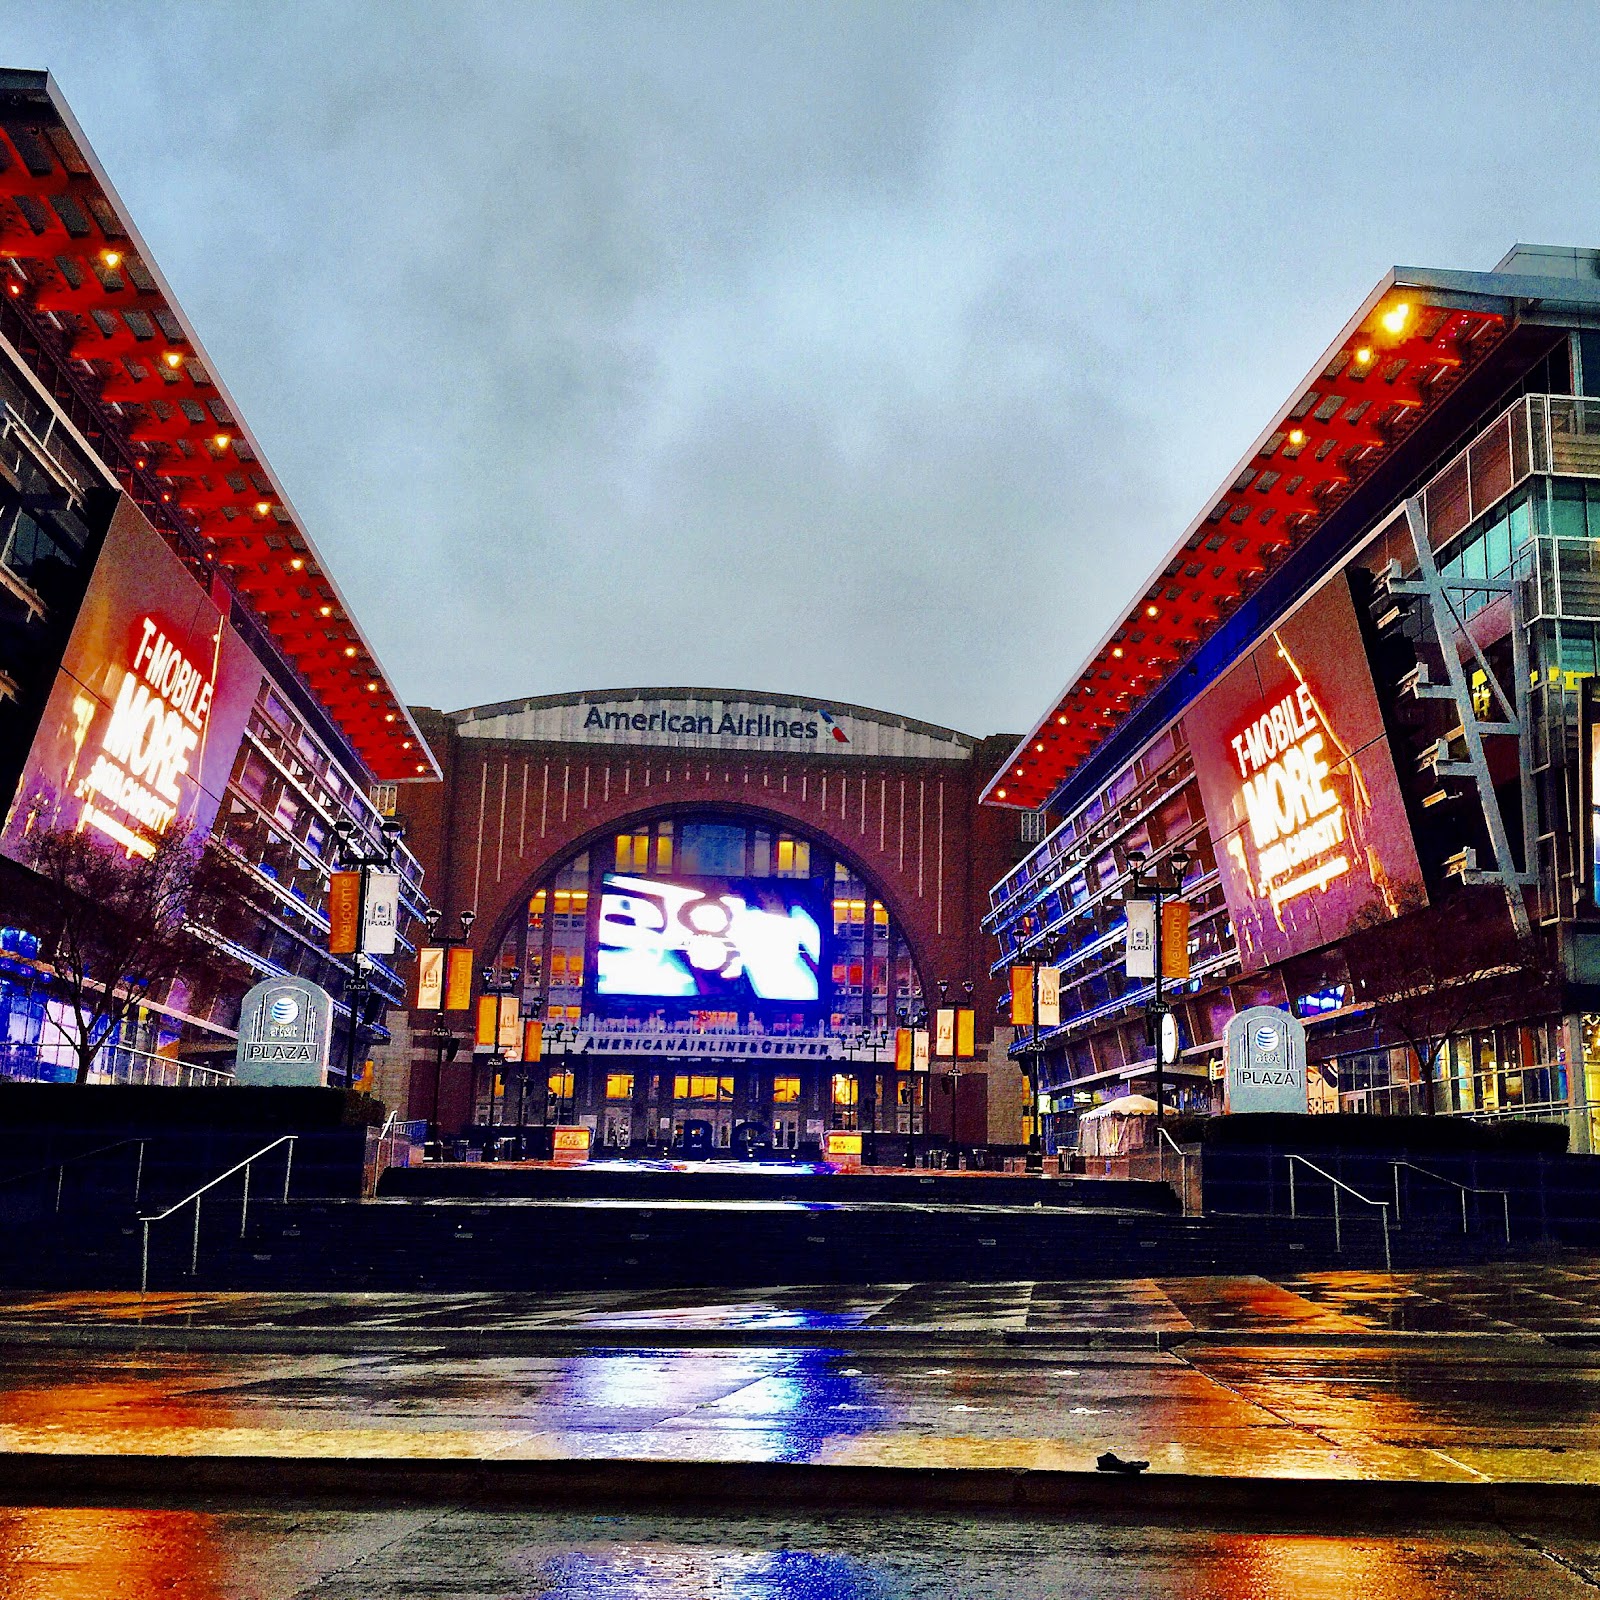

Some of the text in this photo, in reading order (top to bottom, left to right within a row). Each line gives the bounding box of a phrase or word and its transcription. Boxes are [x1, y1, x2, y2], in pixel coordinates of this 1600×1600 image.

[134, 617, 214, 730] T-MOBILE
[102, 671, 199, 806] MORE
[583, 706, 819, 739] American Airlines
[1231, 682, 1317, 778] T-MOBILE
[1242, 733, 1340, 849] MORE
[339, 878, 352, 948] Welcome
[1170, 907, 1183, 974] Welcome
[250, 1045, 311, 1060] PLAZA
[585, 1036, 674, 1052] AMERICAN
[761, 1040, 829, 1056] CENTER
[1242, 1071, 1295, 1085] PLAZA
